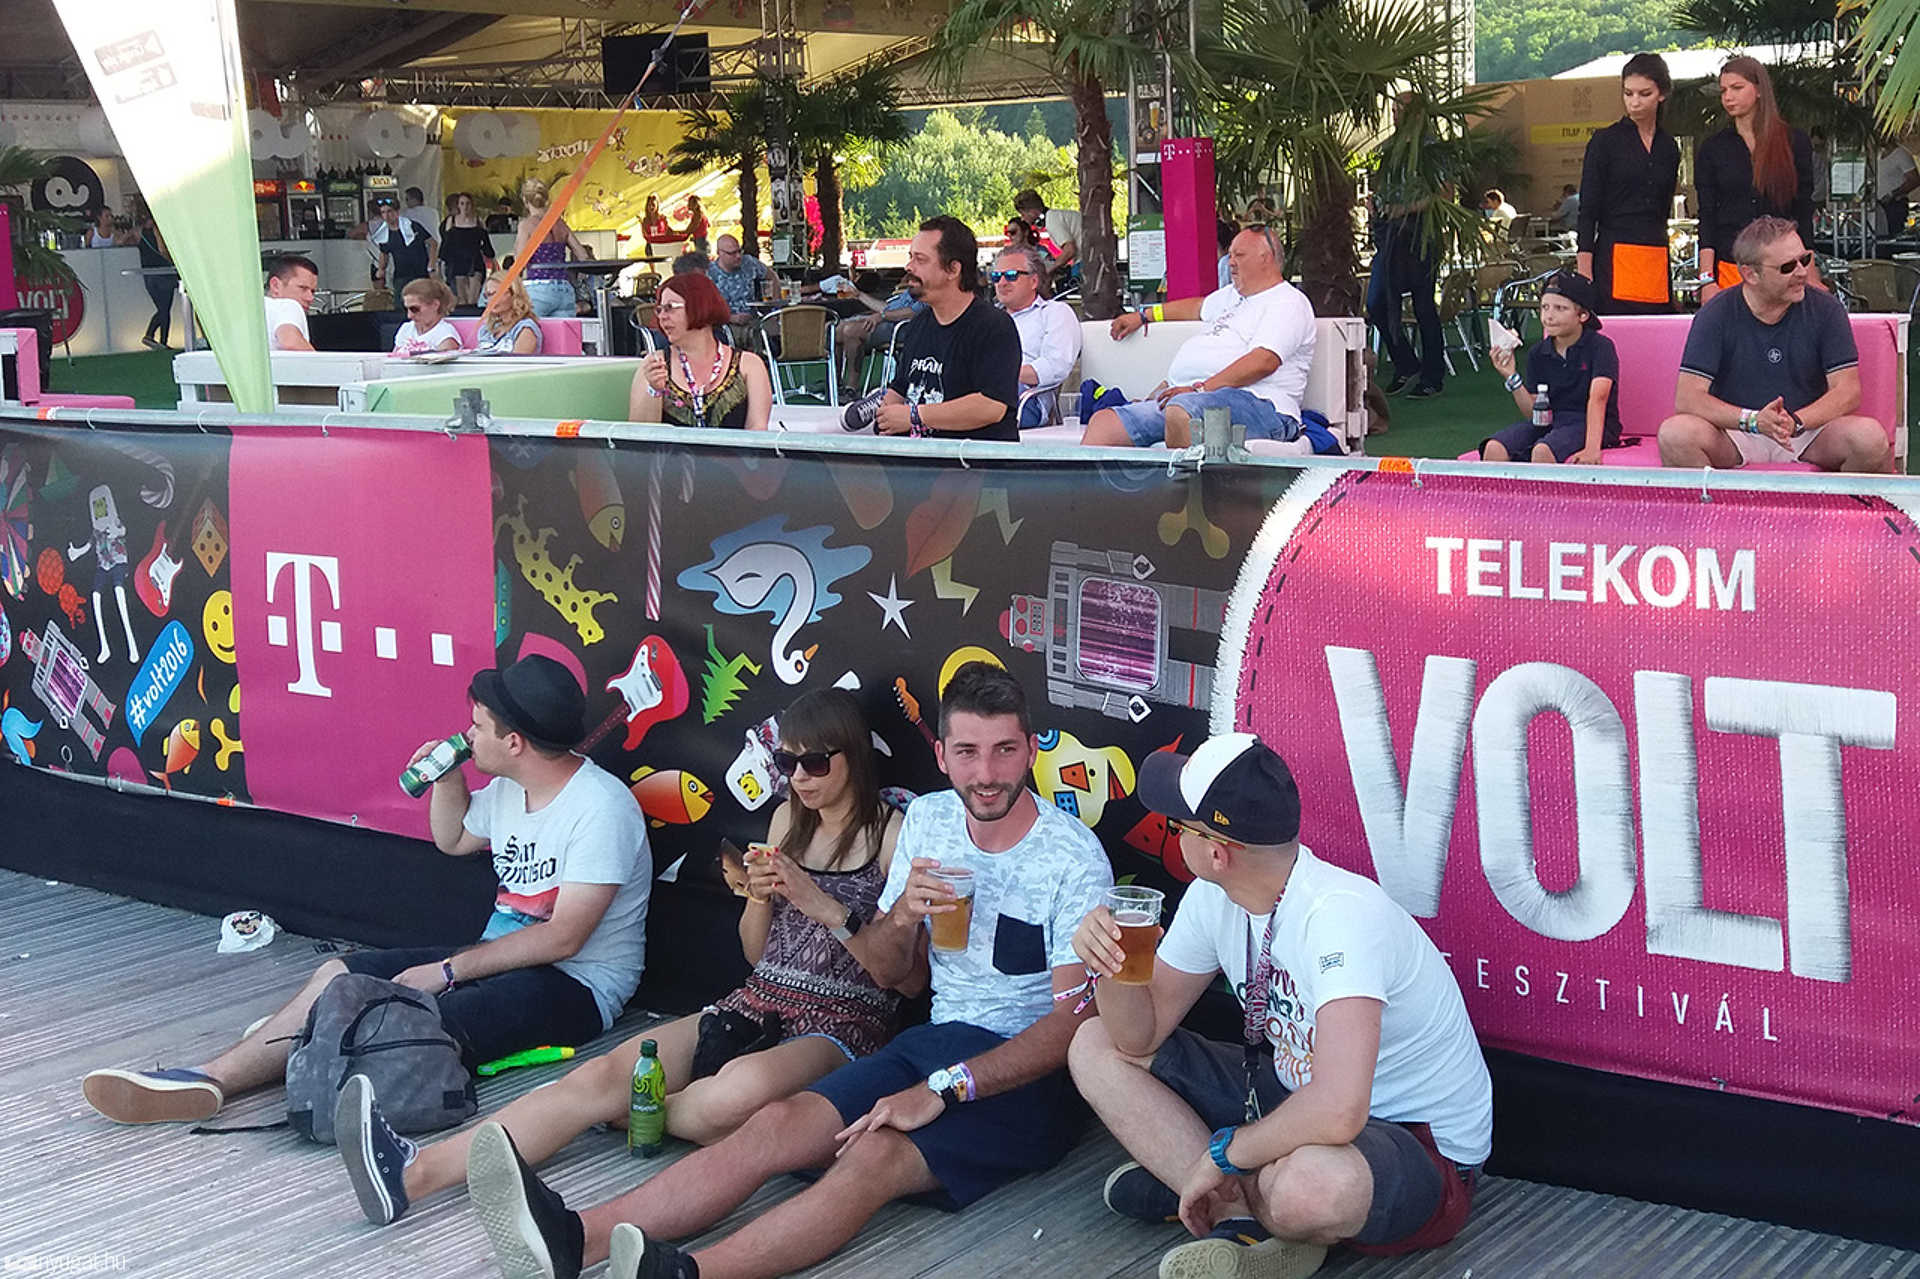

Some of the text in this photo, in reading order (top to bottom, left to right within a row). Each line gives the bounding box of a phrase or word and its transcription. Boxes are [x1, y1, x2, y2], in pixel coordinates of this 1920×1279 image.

[266, 551, 342, 698] T
[1425, 536, 1757, 612] TELEKOM
[129, 627, 188, 729] #volt2016
[1325, 645, 1897, 982] VOLT
